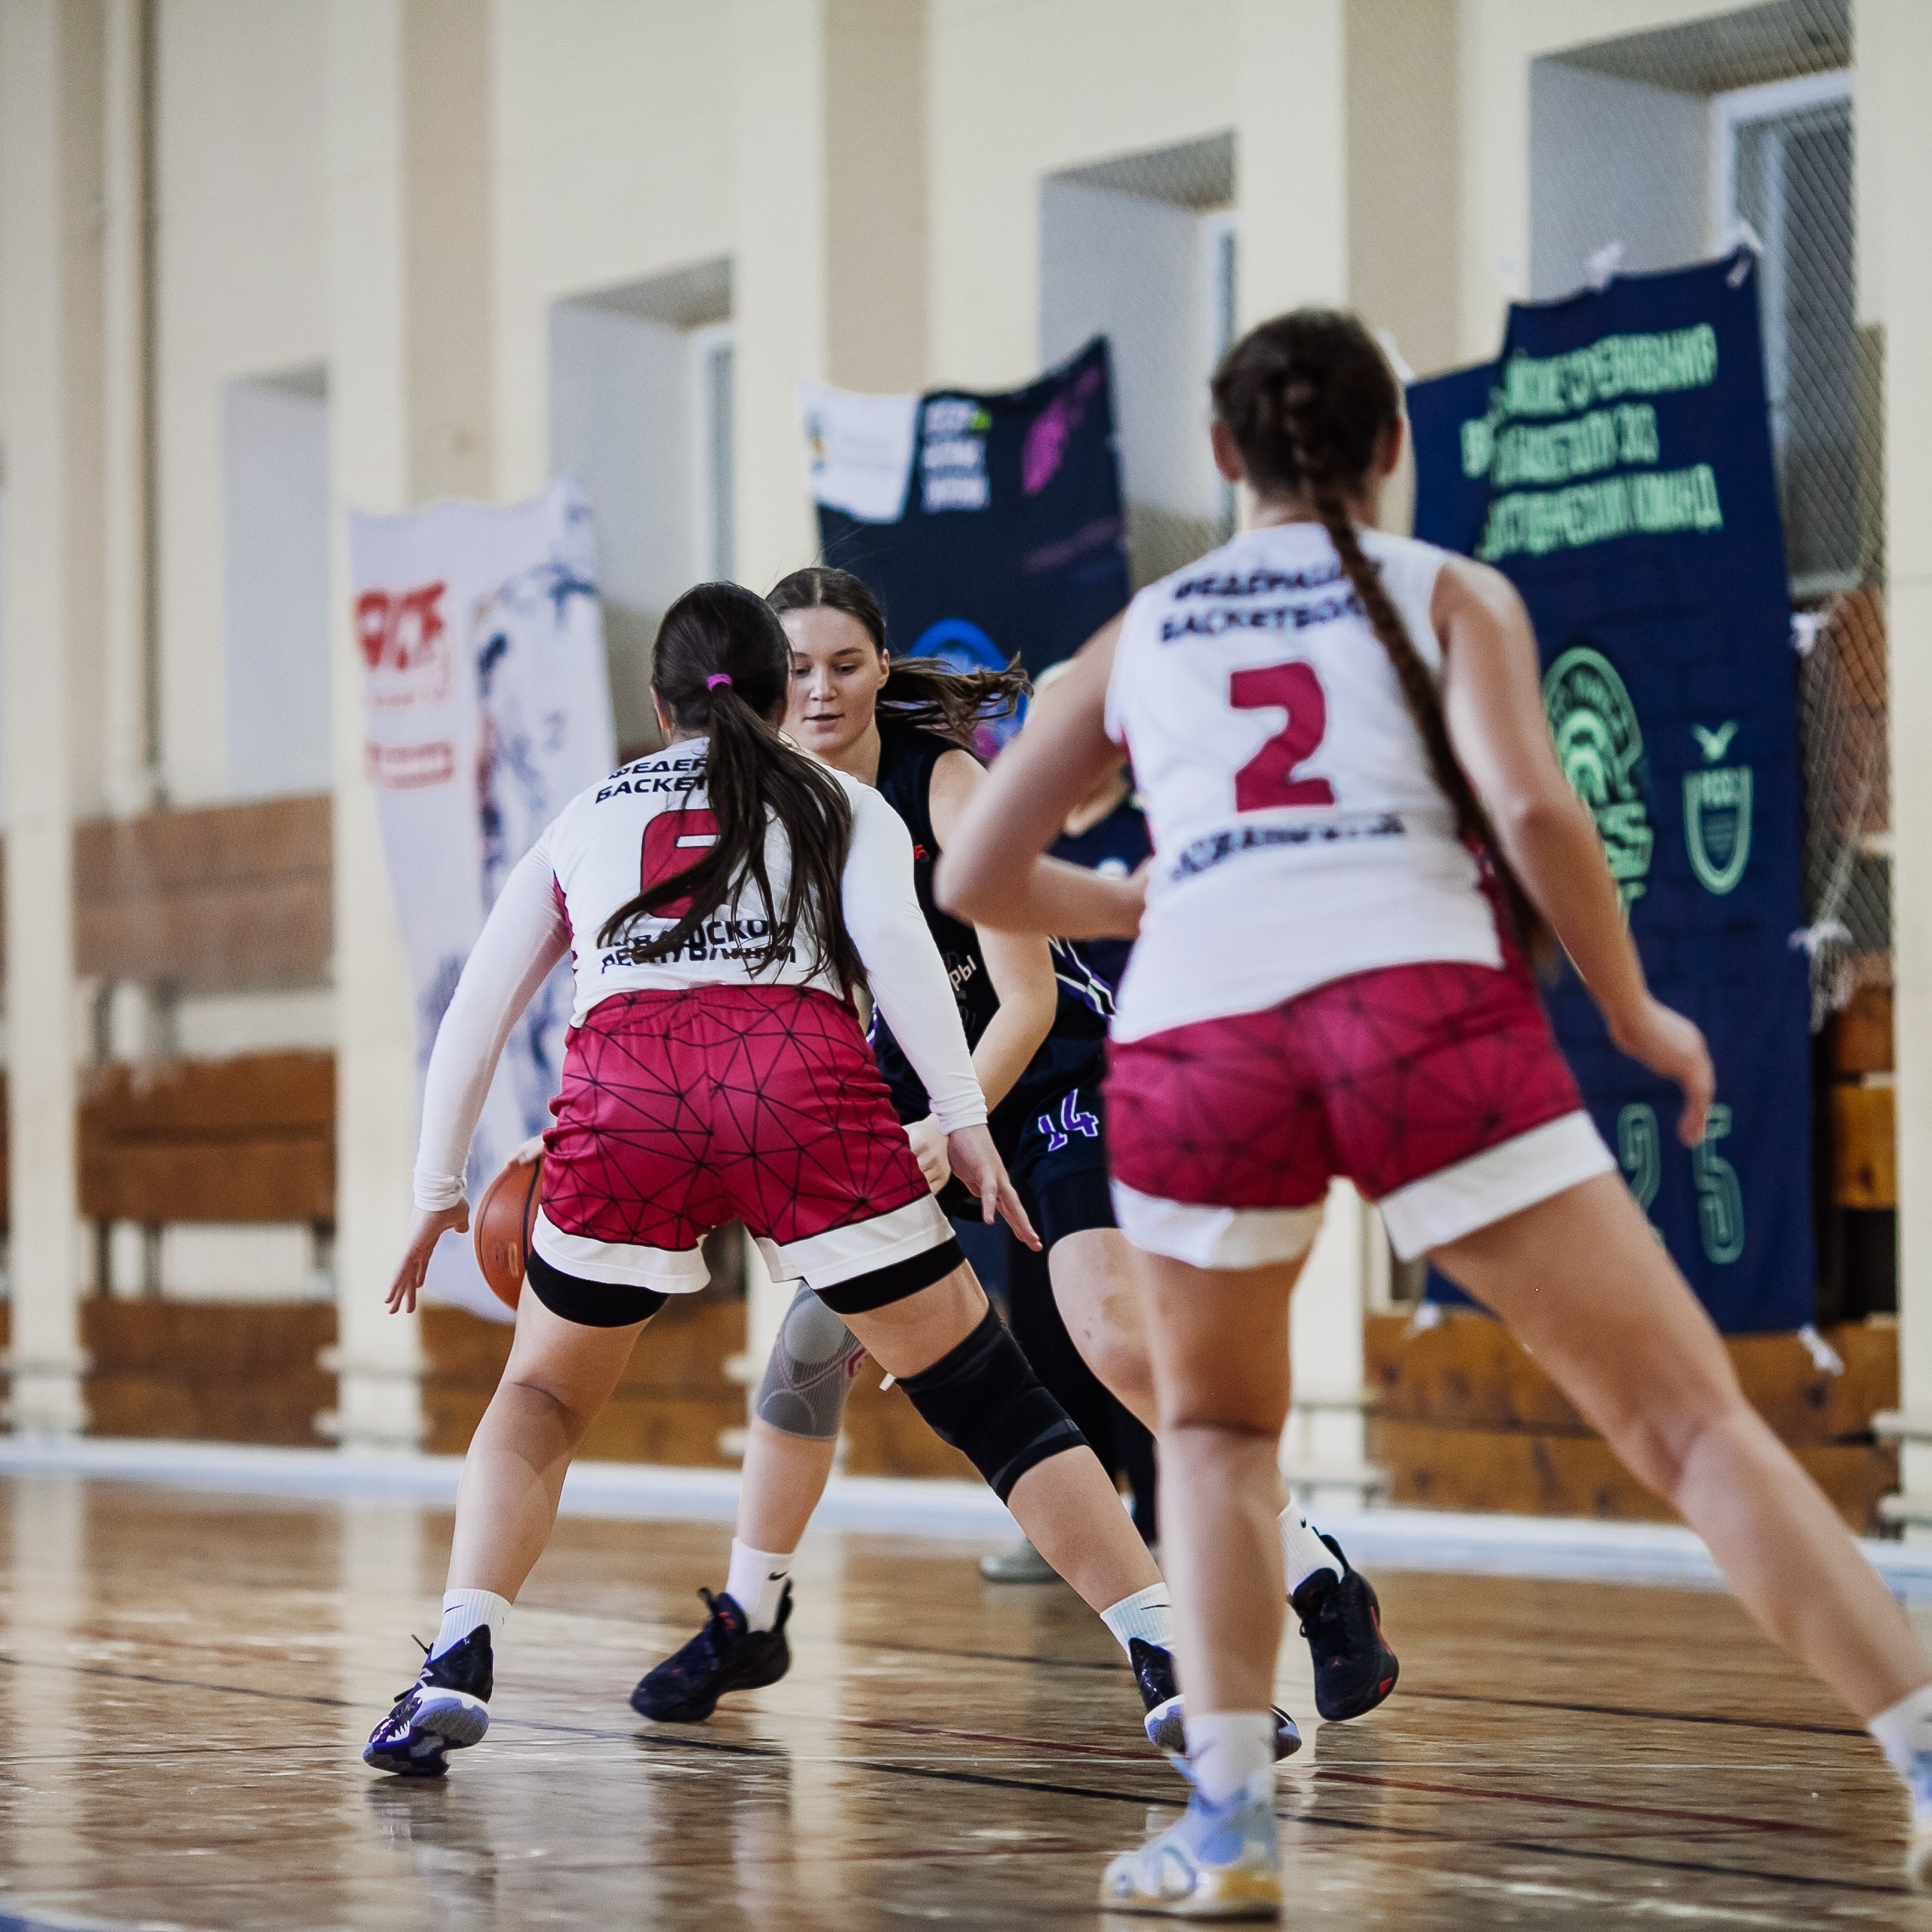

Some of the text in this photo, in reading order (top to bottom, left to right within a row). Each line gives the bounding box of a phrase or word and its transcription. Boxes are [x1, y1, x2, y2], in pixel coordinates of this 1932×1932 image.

[1161, 592, 1367, 642] БАСКЕТБОЛ
[1229, 660, 1336, 814] 2
[595, 776, 708, 804] БАСКЕТ
[608, 758, 708, 780] ФЕДЕР
[1038, 1088, 1099, 1152] 14
